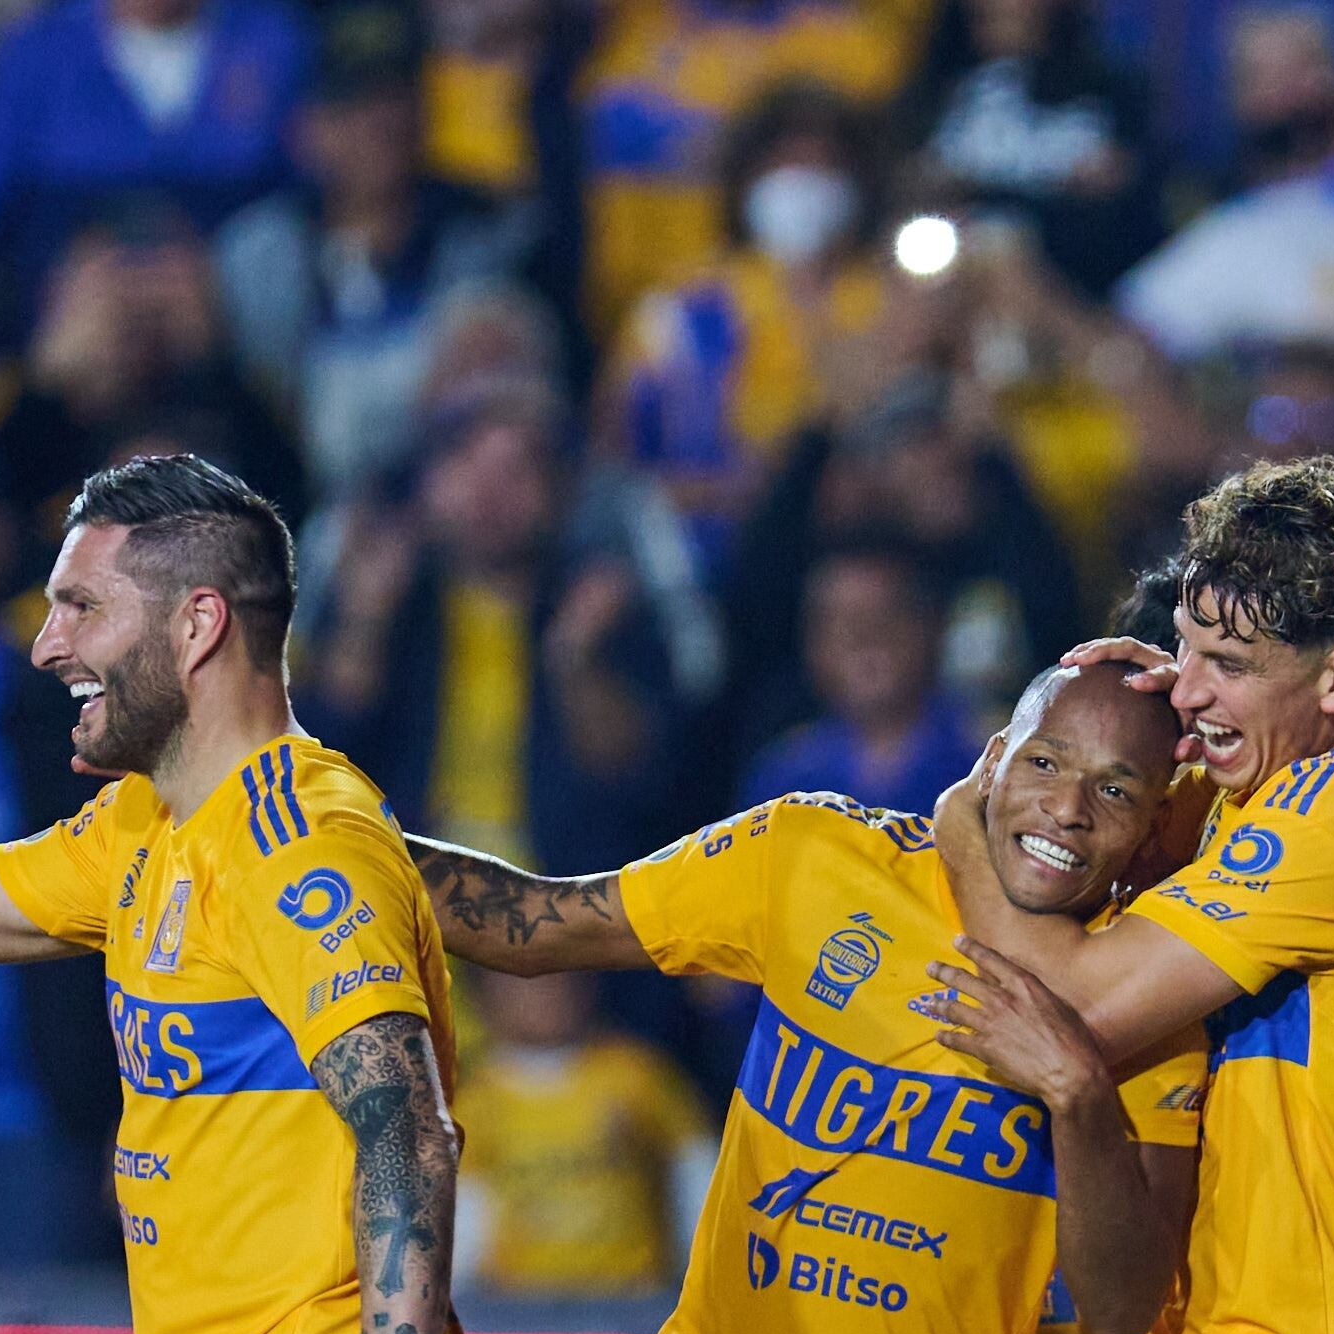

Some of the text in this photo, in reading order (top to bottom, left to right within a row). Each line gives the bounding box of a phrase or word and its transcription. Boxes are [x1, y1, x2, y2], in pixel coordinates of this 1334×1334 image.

[319, 899, 377, 954] Berel
[330, 960, 403, 1002] telcel
[821, 938, 878, 978] MONTERREY
[808, 979, 845, 1006] EXTRA
[764, 1023, 1042, 1180] TIGRES
[794, 1197, 948, 1259] CEMEX
[788, 1254, 908, 1312] Bitso
